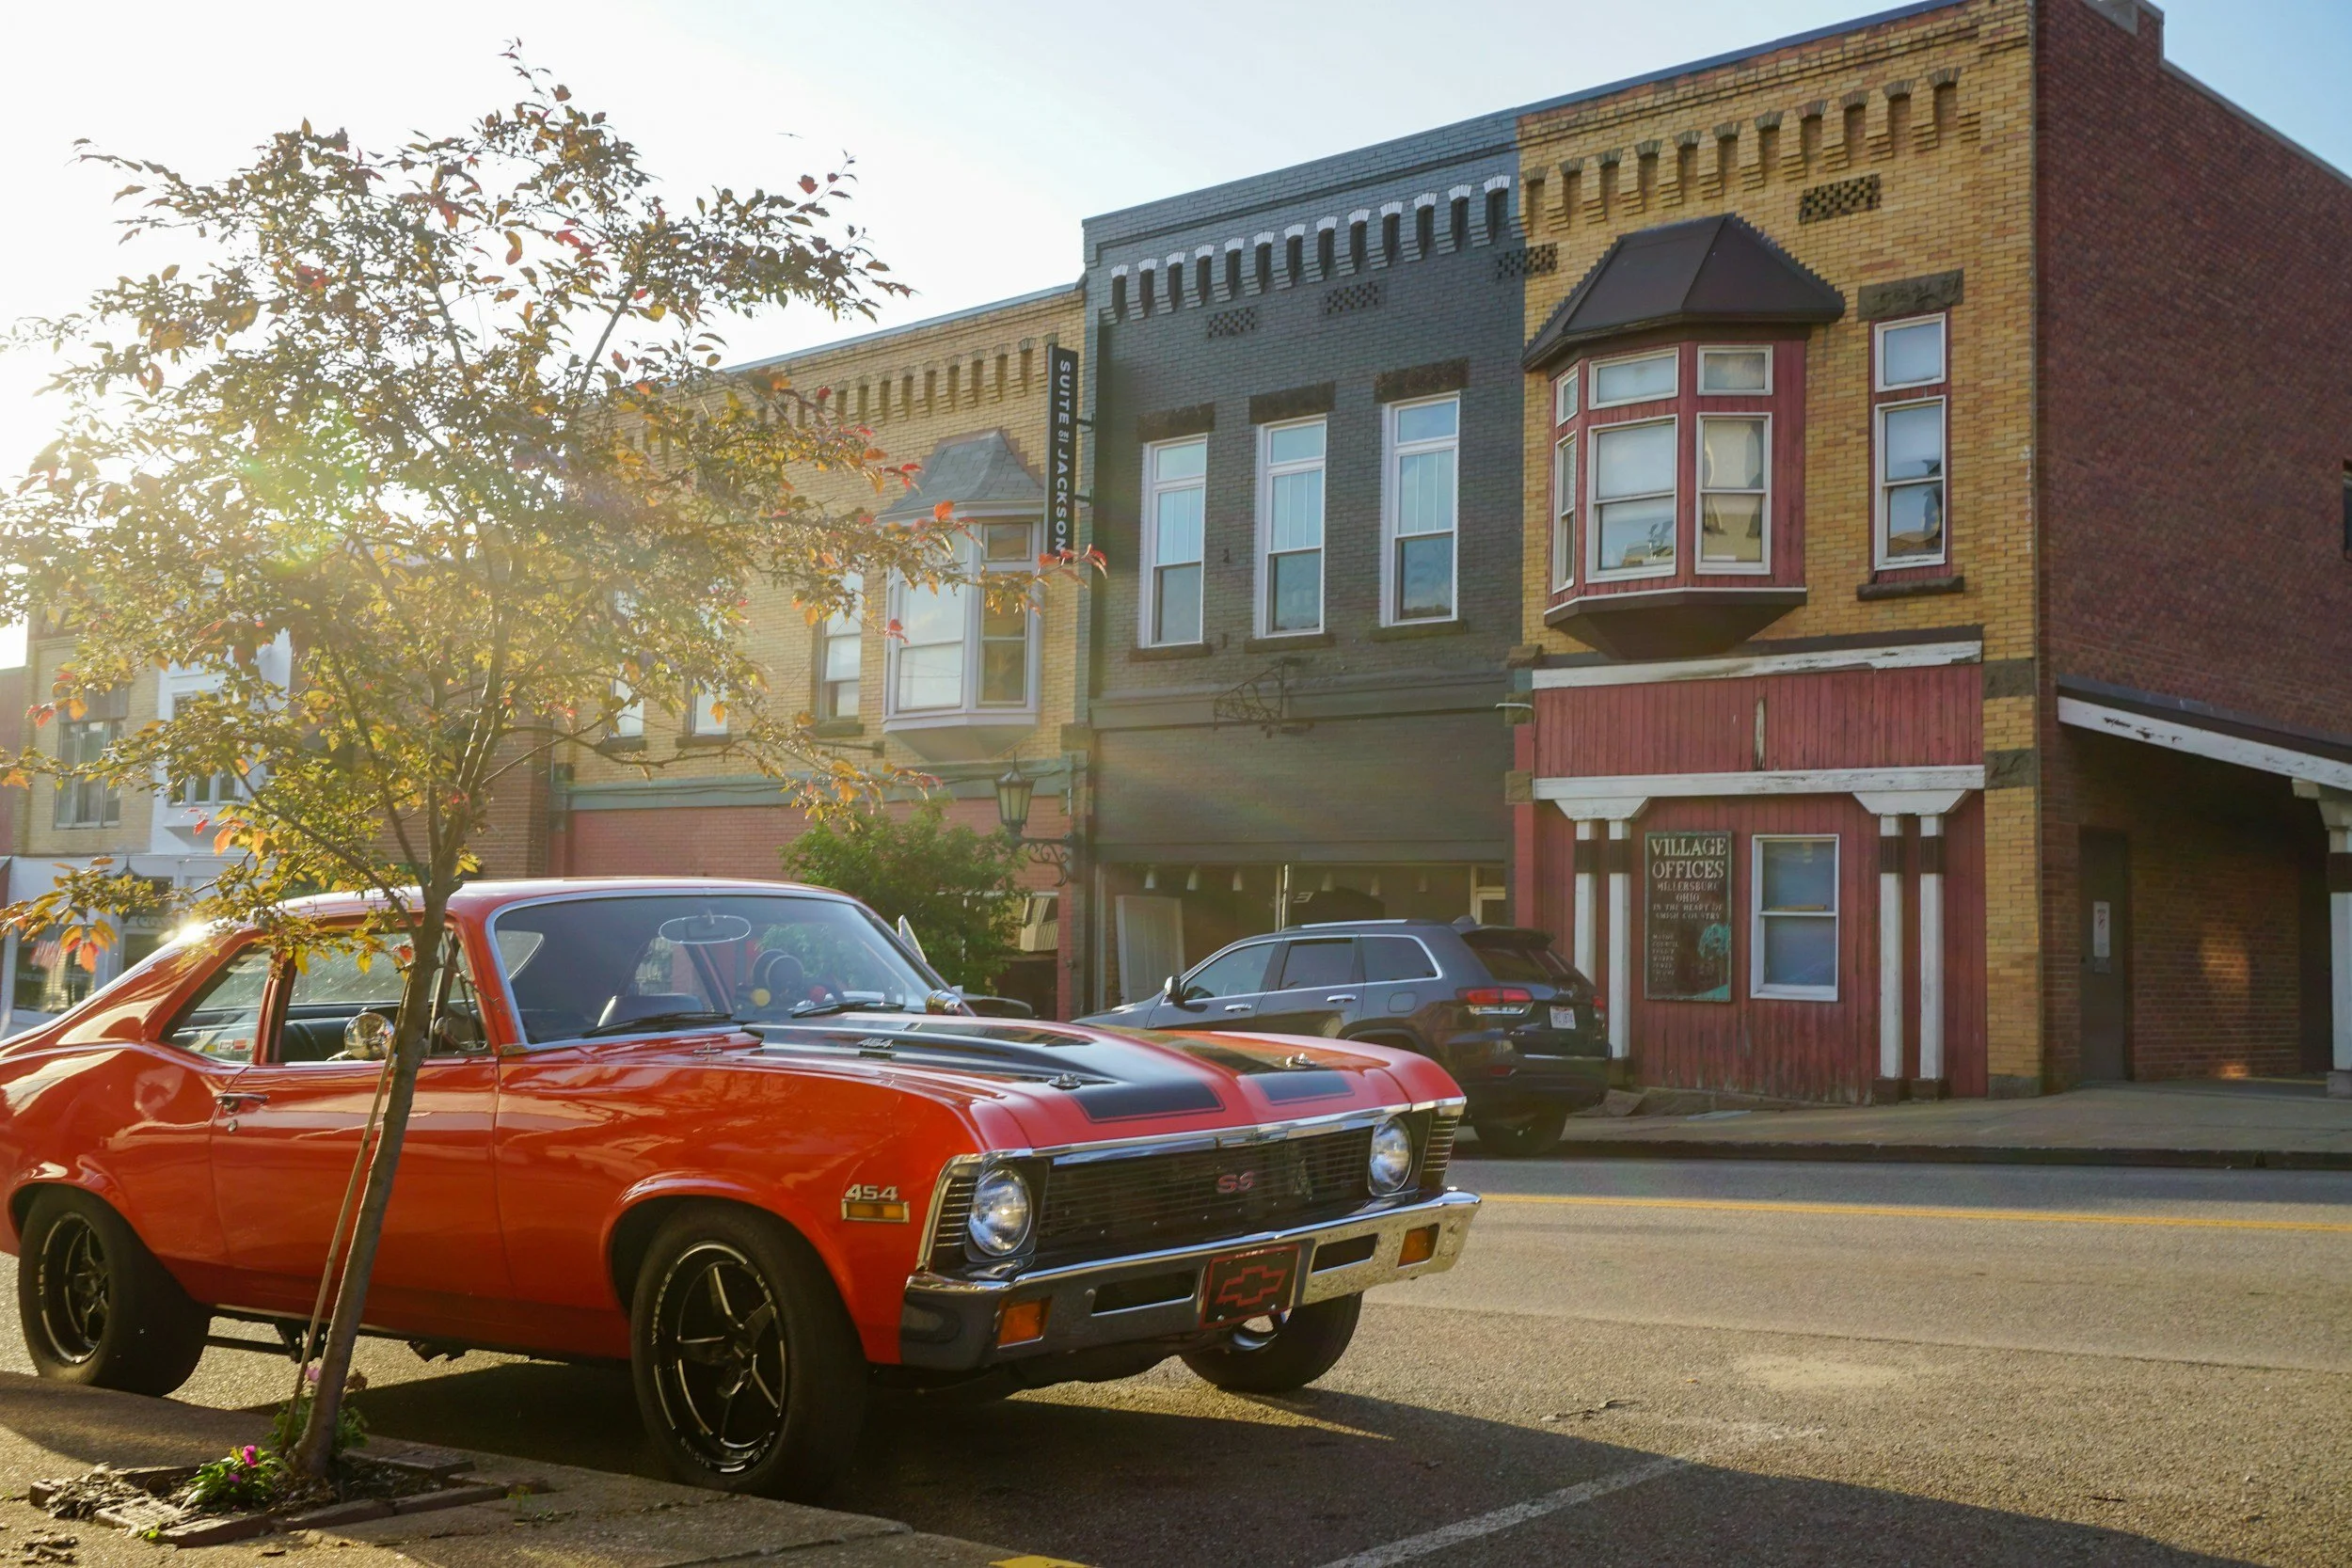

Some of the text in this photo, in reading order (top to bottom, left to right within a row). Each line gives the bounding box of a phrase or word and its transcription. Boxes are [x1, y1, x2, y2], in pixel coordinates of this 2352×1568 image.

[1057, 359, 1071, 424] SUITE
[1055, 447, 1069, 551] JACKSON
[1651, 838, 1725, 857] VILLAGE
[1652, 860, 1724, 879] OFFICES
[1665, 903, 1679, 911] THE
[1676, 893, 1700, 903] OHIO
[845, 1183, 899, 1201] 454
[1216, 1171, 1254, 1194] SS
